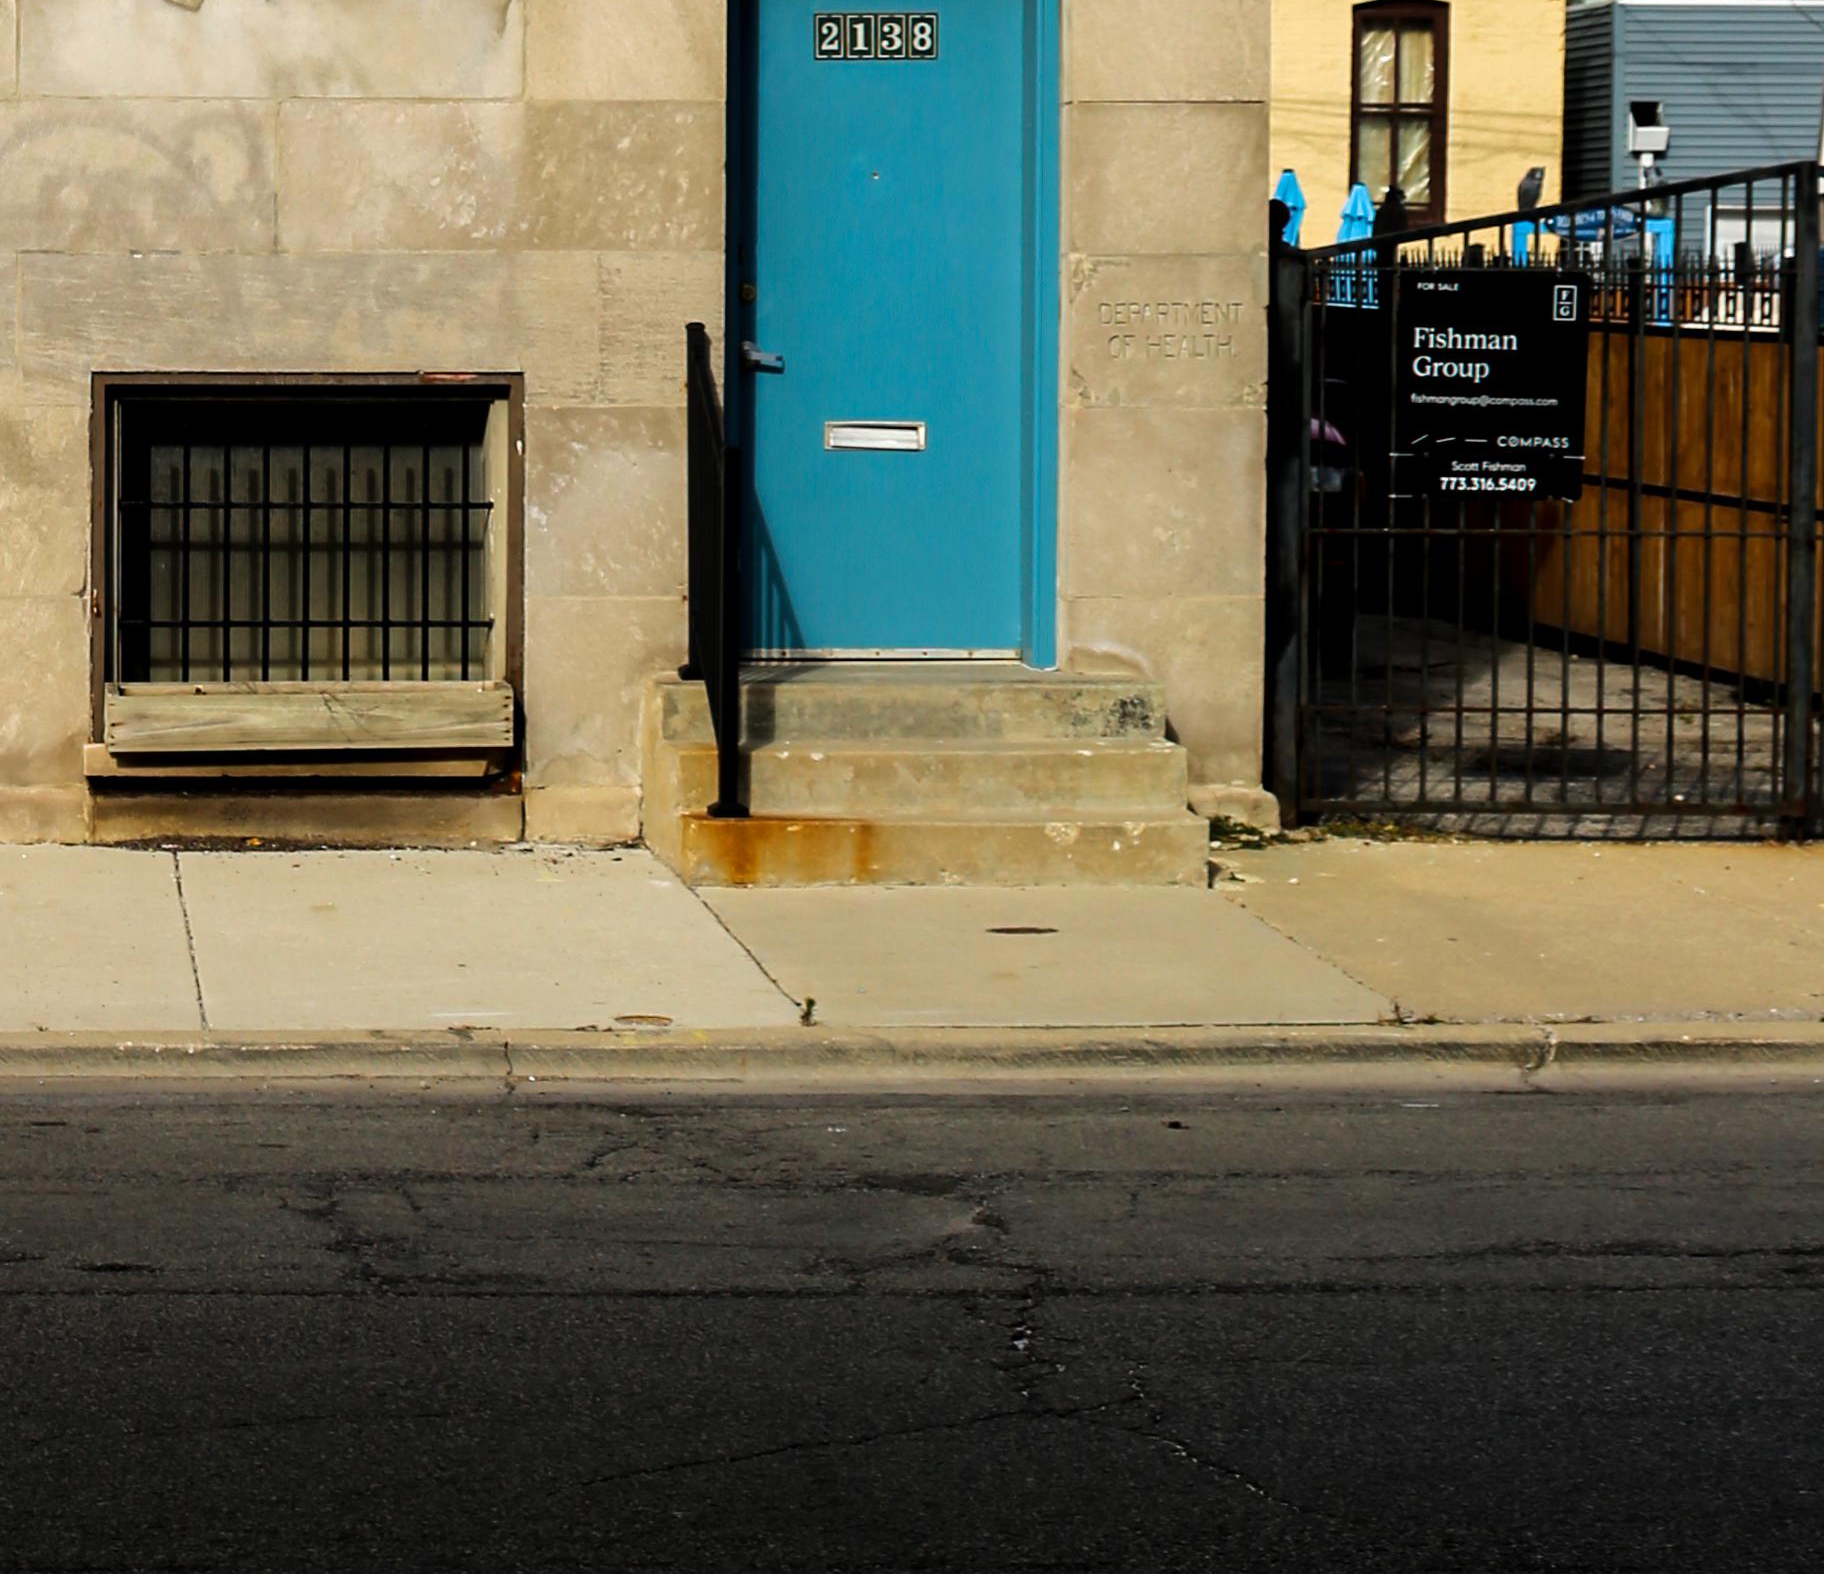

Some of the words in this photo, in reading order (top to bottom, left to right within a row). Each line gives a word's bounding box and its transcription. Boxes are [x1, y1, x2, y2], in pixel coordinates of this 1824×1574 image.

[820, 21, 933, 51] 2138
[1417, 282, 1434, 291] FOR
[1437, 283, 1459, 292] SALE
[1098, 302, 1244, 326] DEPARTMENT
[1107, 334, 1136, 358] OF
[1413, 327, 1518, 350] Fishman
[1412, 355, 1490, 383] Group
[1410, 393, 1558, 407] fishmangroup@compass.com
[1496, 436, 1570, 448] COMPASS
[1451, 461, 1480, 472] Scott
[1482, 461, 1527, 472] Fishman
[1440, 477, 1537, 491] 773.316.5409
